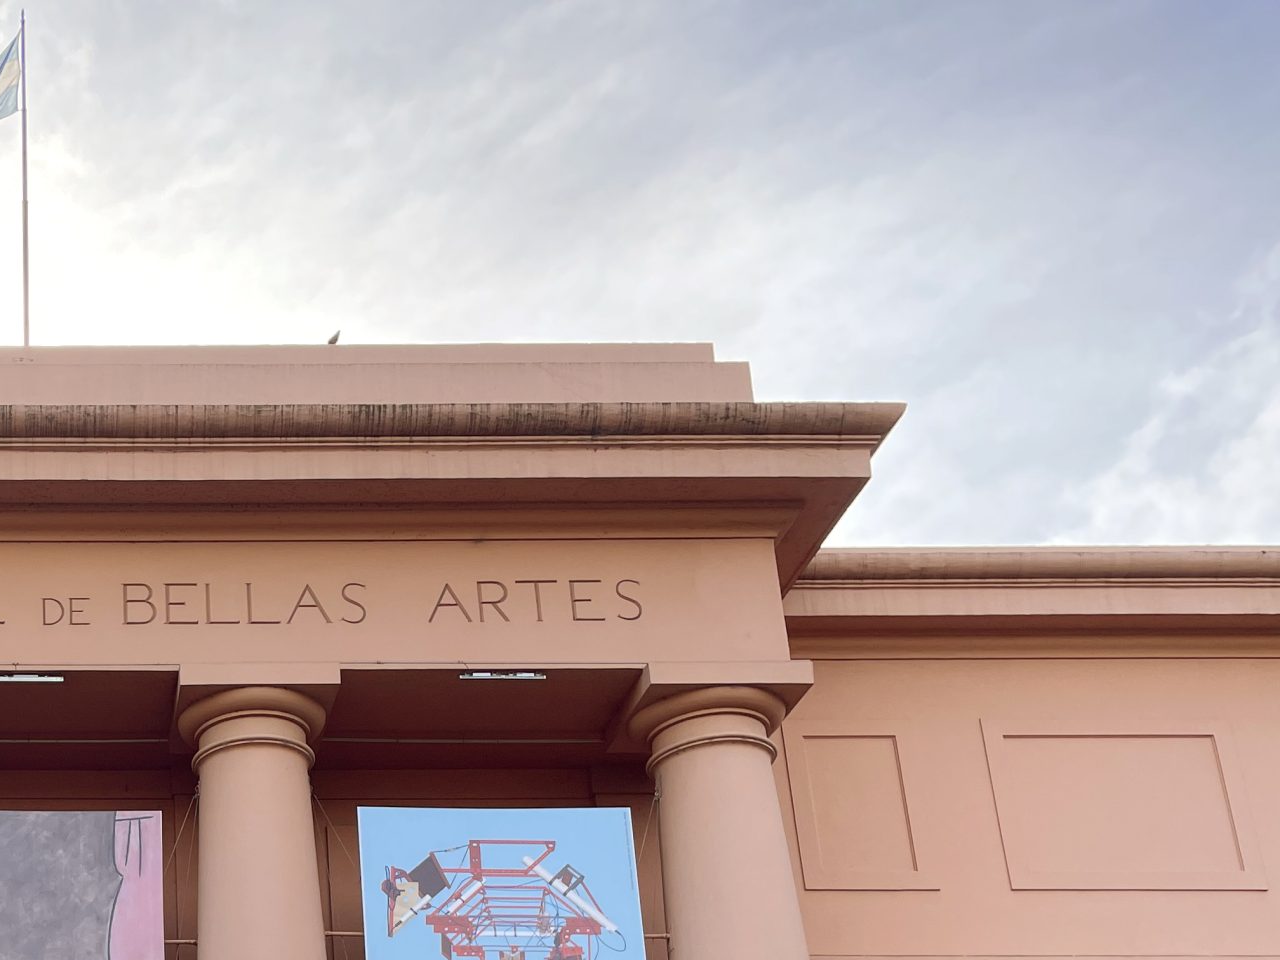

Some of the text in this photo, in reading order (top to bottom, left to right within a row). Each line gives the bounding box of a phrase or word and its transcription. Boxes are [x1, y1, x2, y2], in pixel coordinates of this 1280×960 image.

[41, 597, 91, 626] DE
[120, 582, 367, 626] BELLAS
[428, 578, 643, 624] ARTES
